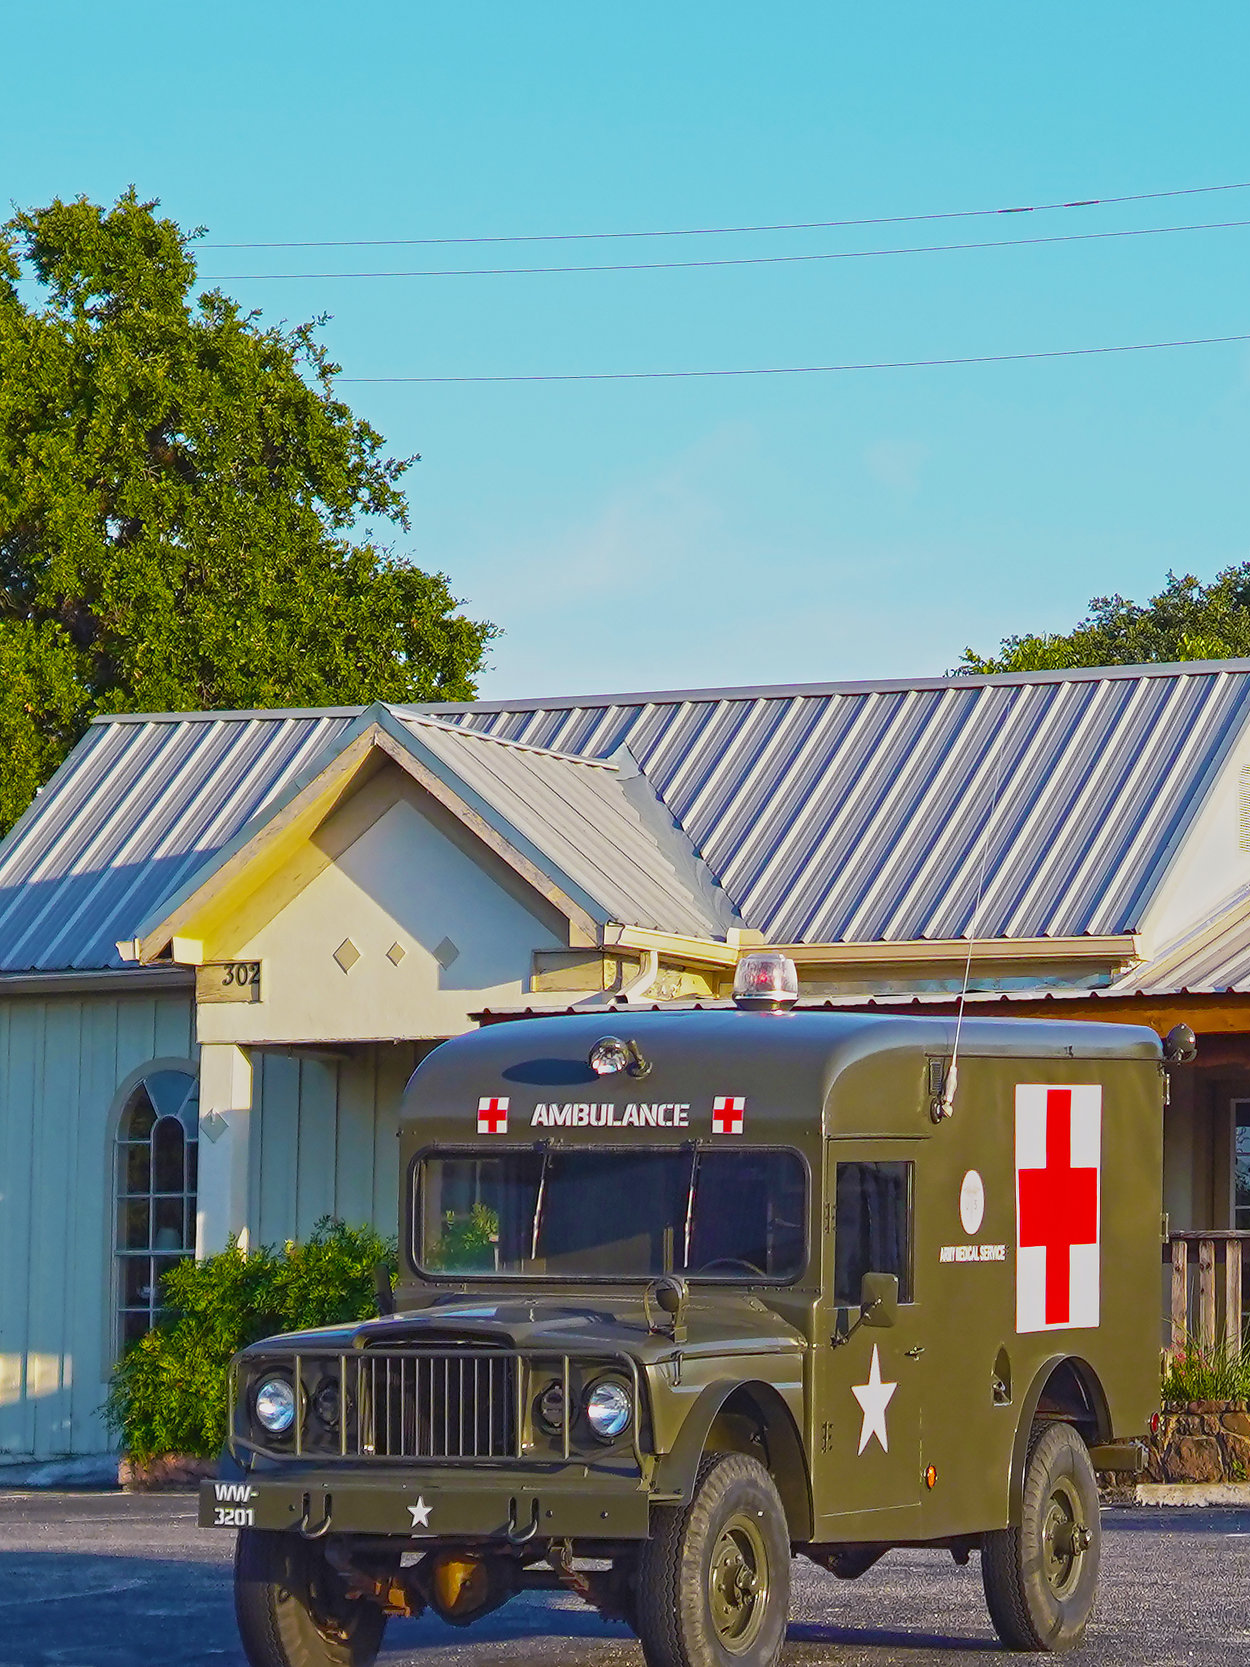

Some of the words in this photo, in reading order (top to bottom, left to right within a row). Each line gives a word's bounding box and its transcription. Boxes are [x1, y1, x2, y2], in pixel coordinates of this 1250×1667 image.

[222, 964, 260, 987] 302
[530, 1103, 691, 1127] AMBULANCE
[980, 1244, 1006, 1261] SERVICE
[213, 1507, 254, 1526] 3201
